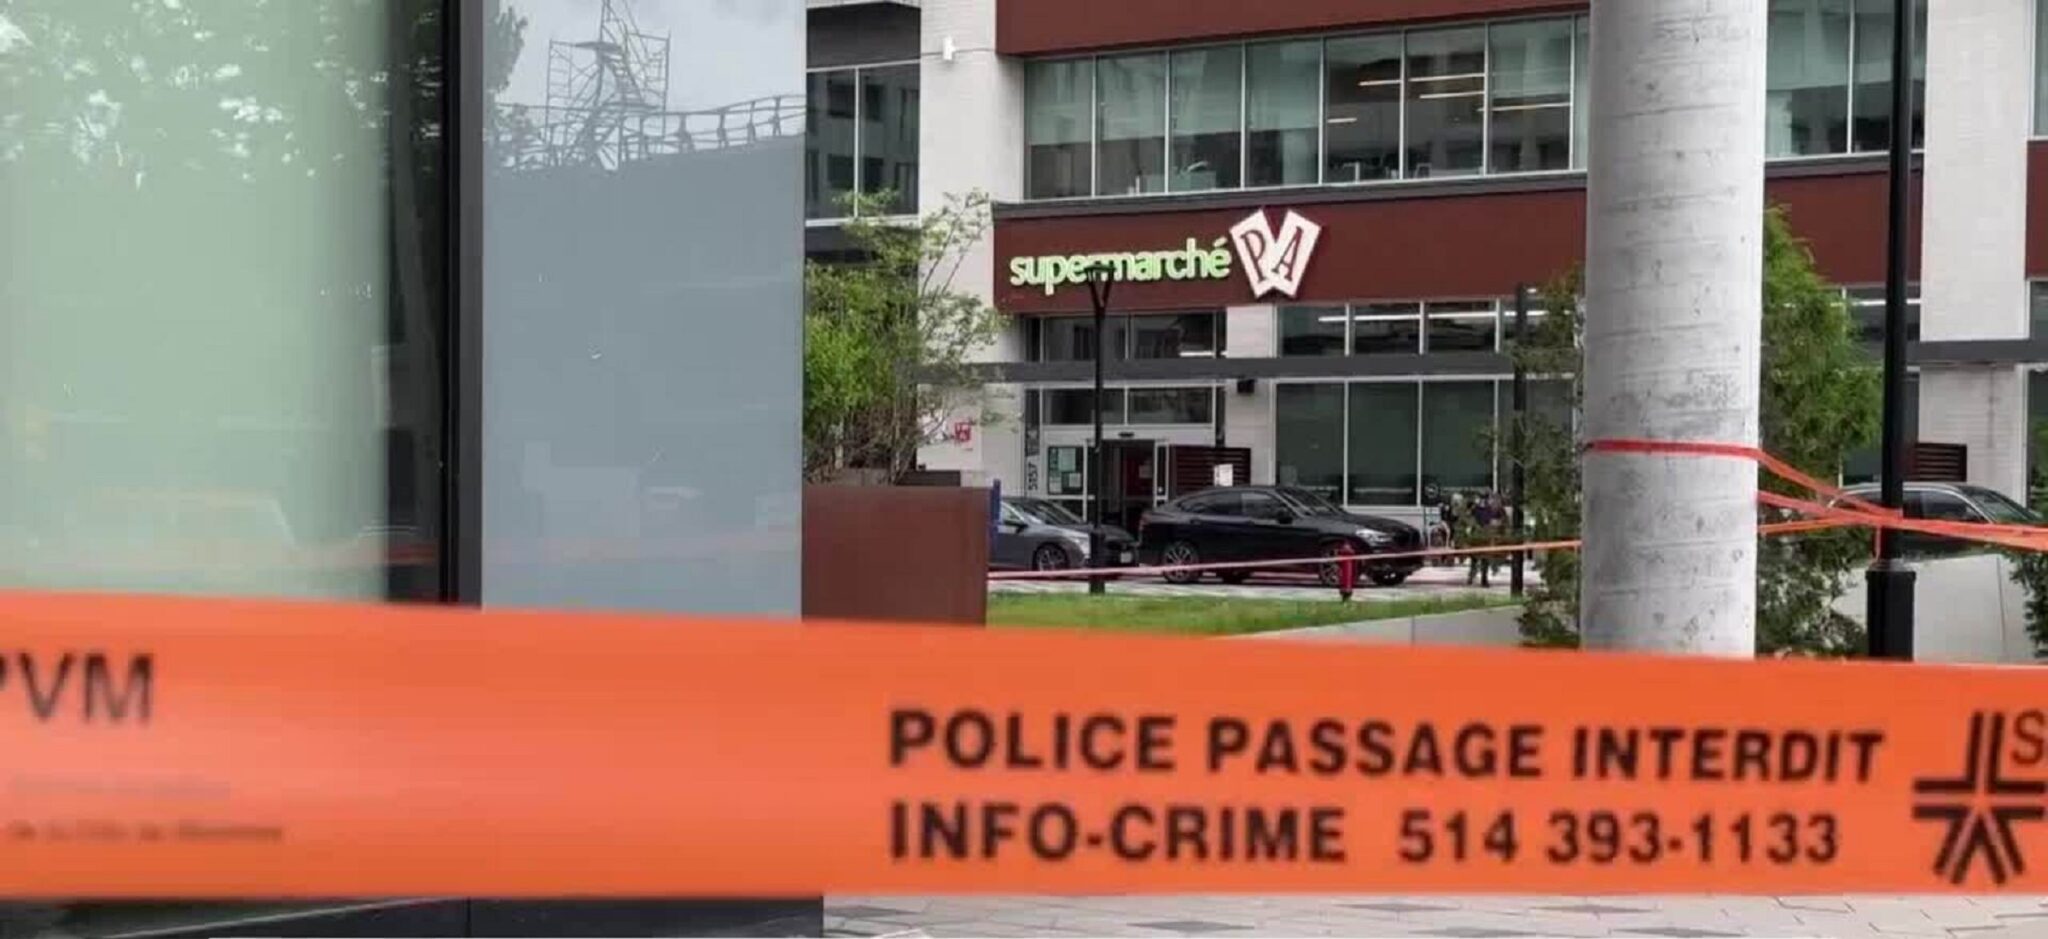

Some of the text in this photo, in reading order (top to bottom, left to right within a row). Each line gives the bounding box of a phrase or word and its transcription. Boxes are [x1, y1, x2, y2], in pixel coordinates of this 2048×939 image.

[1010, 237, 1232, 295] supermarché
[889, 709, 1884, 783] POLICE PASSAGE INTERDIT
[889, 800, 1839, 865] INFO-CRIME 514 393-1133
